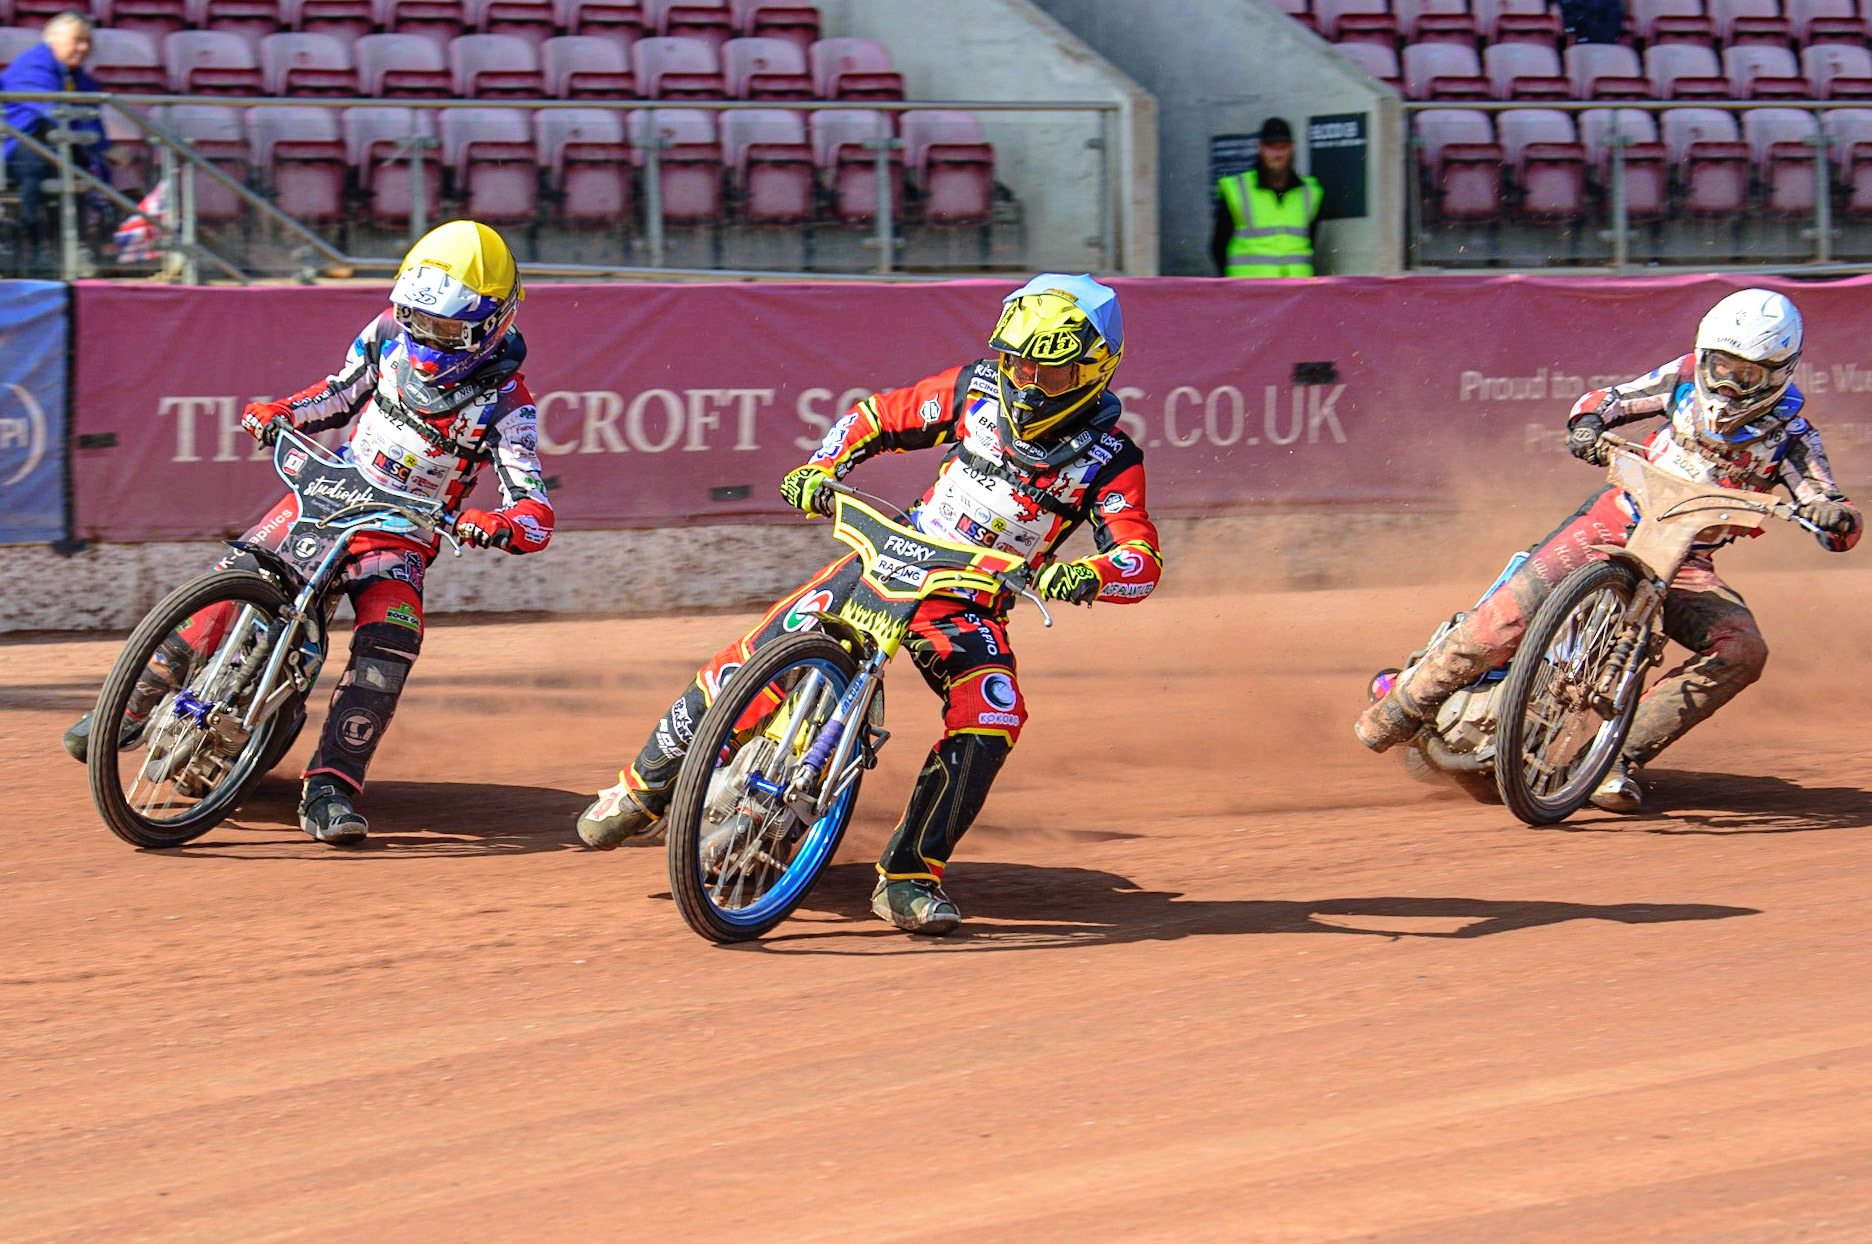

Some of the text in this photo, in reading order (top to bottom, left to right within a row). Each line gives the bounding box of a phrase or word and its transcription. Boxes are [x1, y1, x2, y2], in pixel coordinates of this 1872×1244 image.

[974, 363, 998, 382] RISK
[1460, 367, 1549, 401] Proud
[973, 380, 999, 395] ACING
[157, 395, 273, 462] TH
[534, 387, 775, 455] CROFT
[978, 416, 997, 432] BR
[1100, 432, 1123, 454] RISKY
[962, 467, 996, 492] 2022
[957, 516, 996, 546] NSSC
[884, 535, 937, 561] FRISKY
[878, 560, 921, 581] RACING
